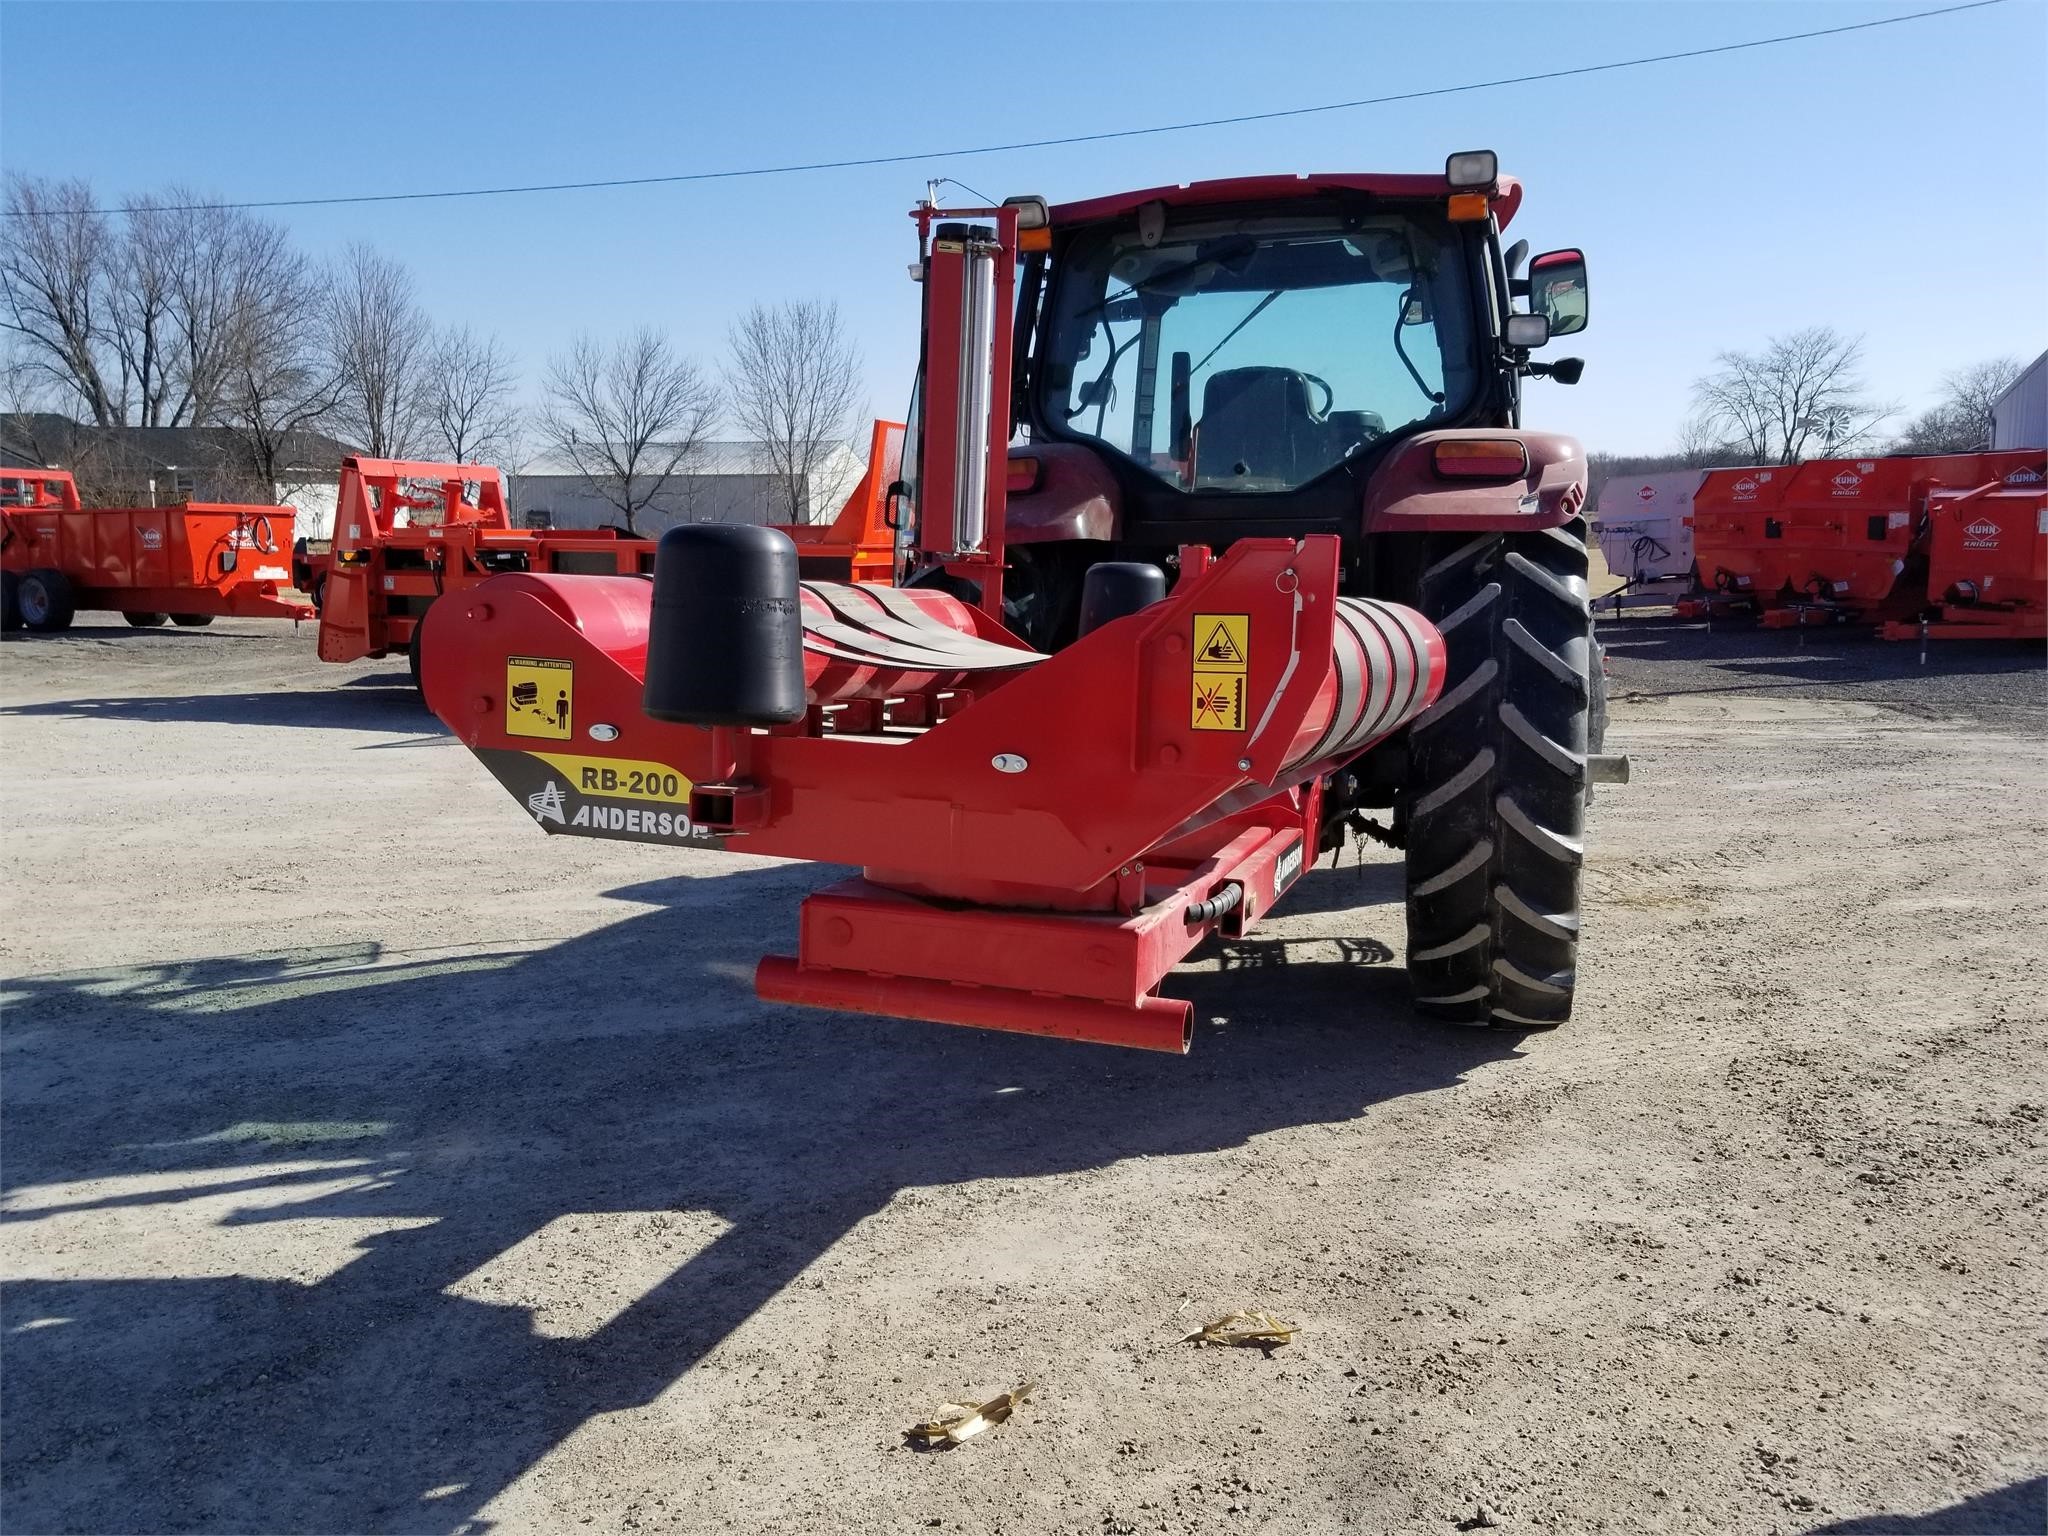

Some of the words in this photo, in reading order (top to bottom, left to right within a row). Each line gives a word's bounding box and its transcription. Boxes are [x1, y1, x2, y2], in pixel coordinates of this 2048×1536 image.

[1836, 476, 1858, 484] KUHN
[2009, 473, 2036, 482] KUHN
[1968, 525, 1995, 534] KUHN
[582, 766, 678, 797] RB-200
